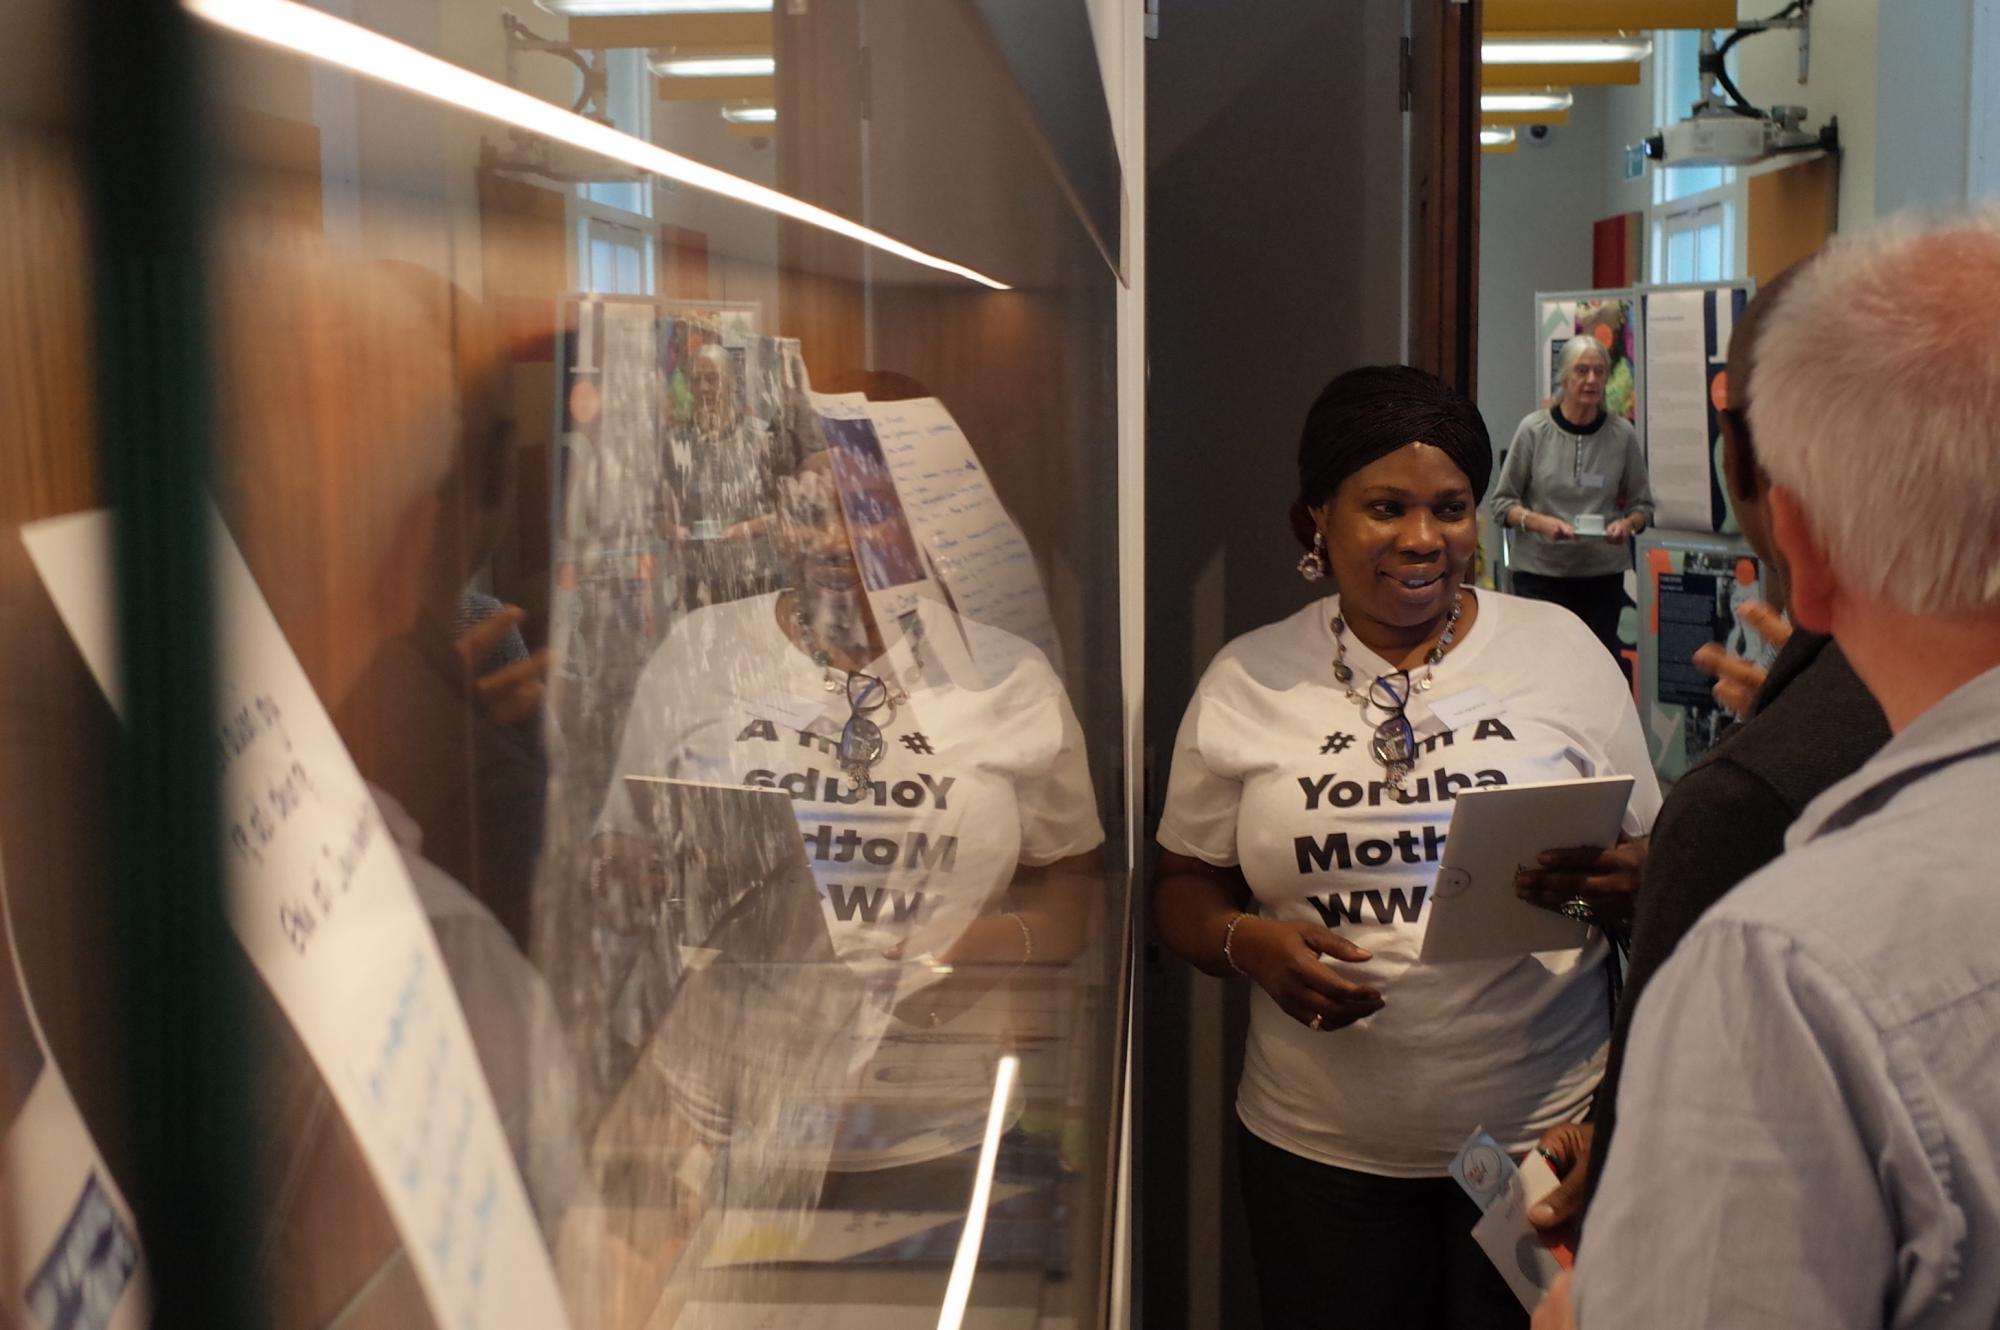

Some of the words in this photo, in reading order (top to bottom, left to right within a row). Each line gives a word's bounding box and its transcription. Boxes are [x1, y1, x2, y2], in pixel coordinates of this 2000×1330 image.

[1472, 717, 1516, 742] A
[1297, 767, 1508, 811] Yoruba
[1293, 826, 1447, 874] Moth
[1306, 886, 1432, 929] WW
